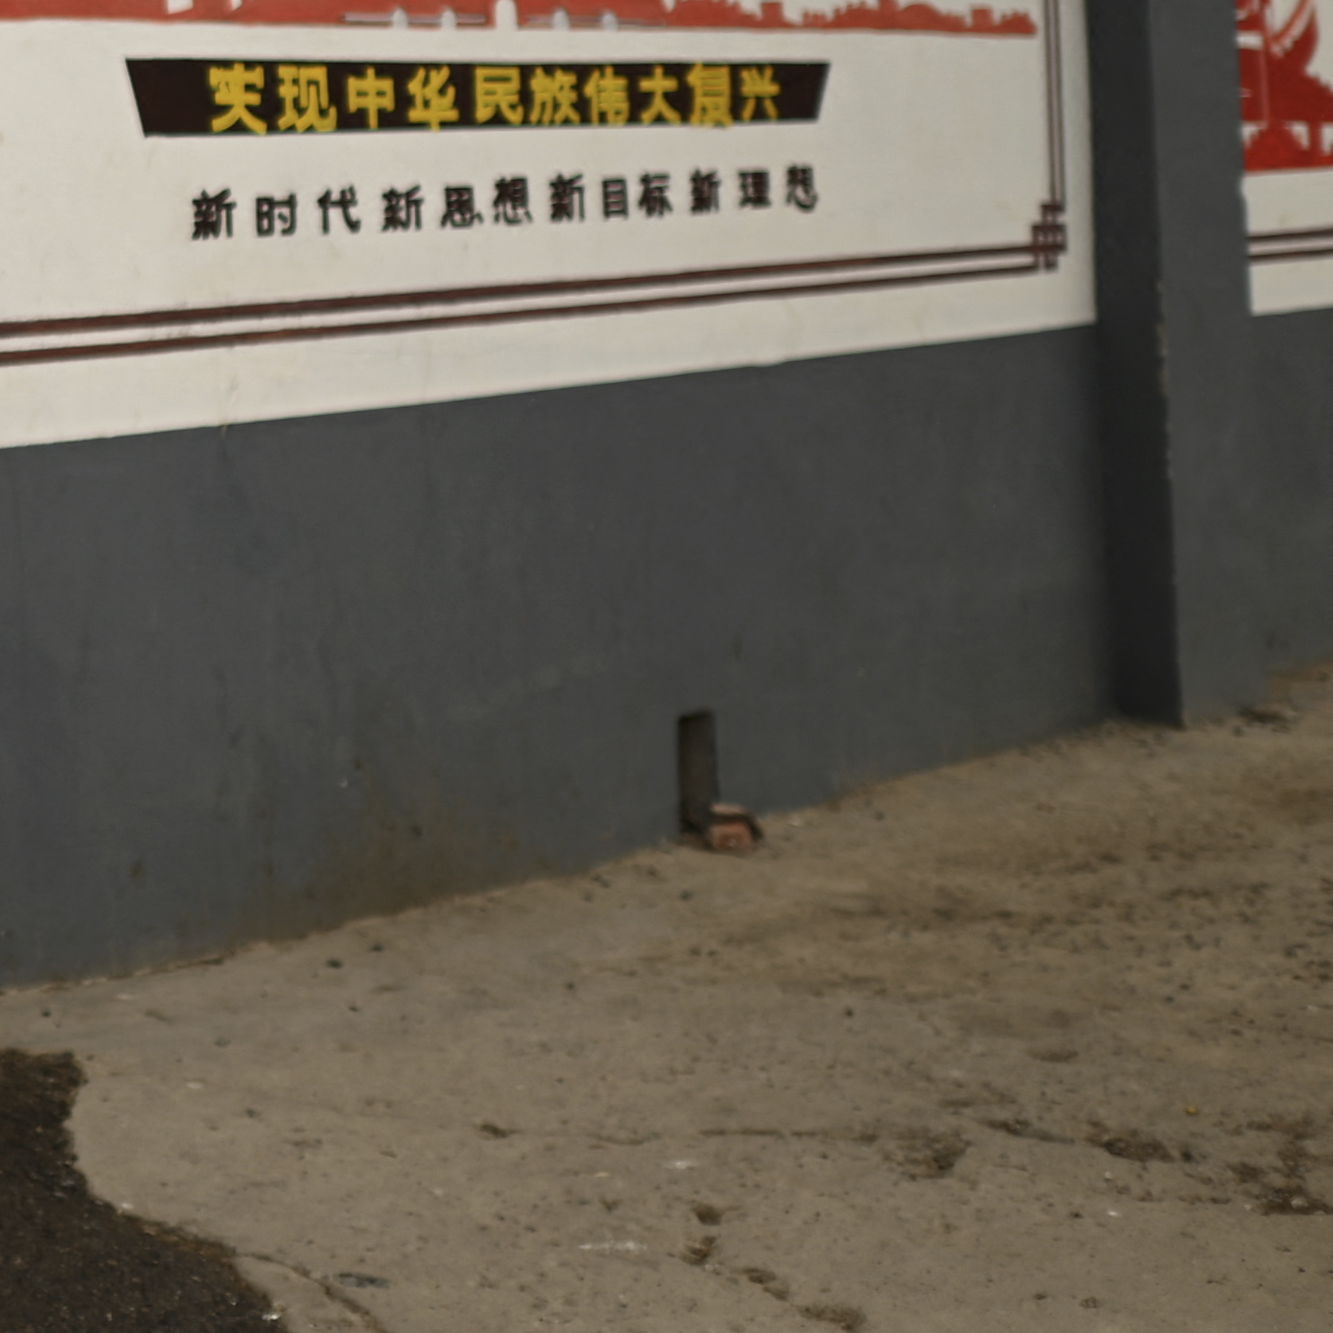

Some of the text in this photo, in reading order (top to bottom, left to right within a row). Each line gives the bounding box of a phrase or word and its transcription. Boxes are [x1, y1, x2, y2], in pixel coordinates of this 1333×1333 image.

[209, 62, 781, 135] 实现中华民族伟大复兴
[190, 164, 818, 240] 新时代新思想新目标新理念
